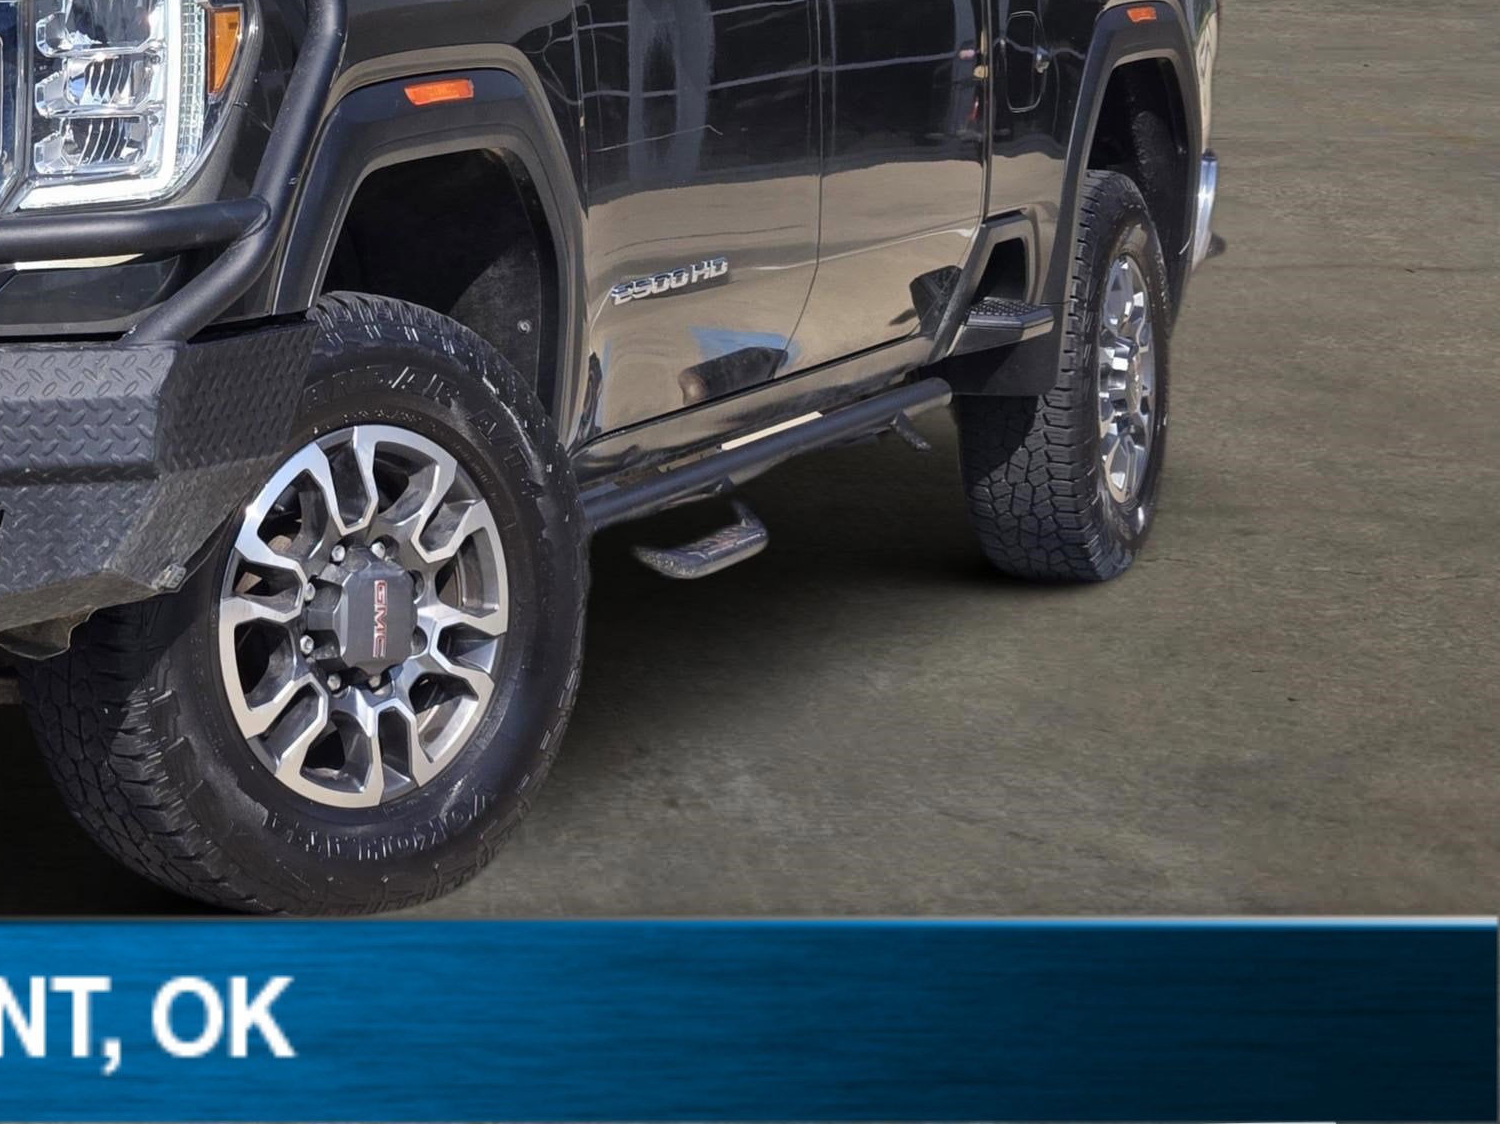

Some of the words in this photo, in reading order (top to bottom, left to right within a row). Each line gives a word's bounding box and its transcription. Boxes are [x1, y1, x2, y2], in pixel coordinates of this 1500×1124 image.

[610, 267, 690, 306] 2500
[690, 256, 729, 284] HD
[373, 579, 388, 658] GMC
